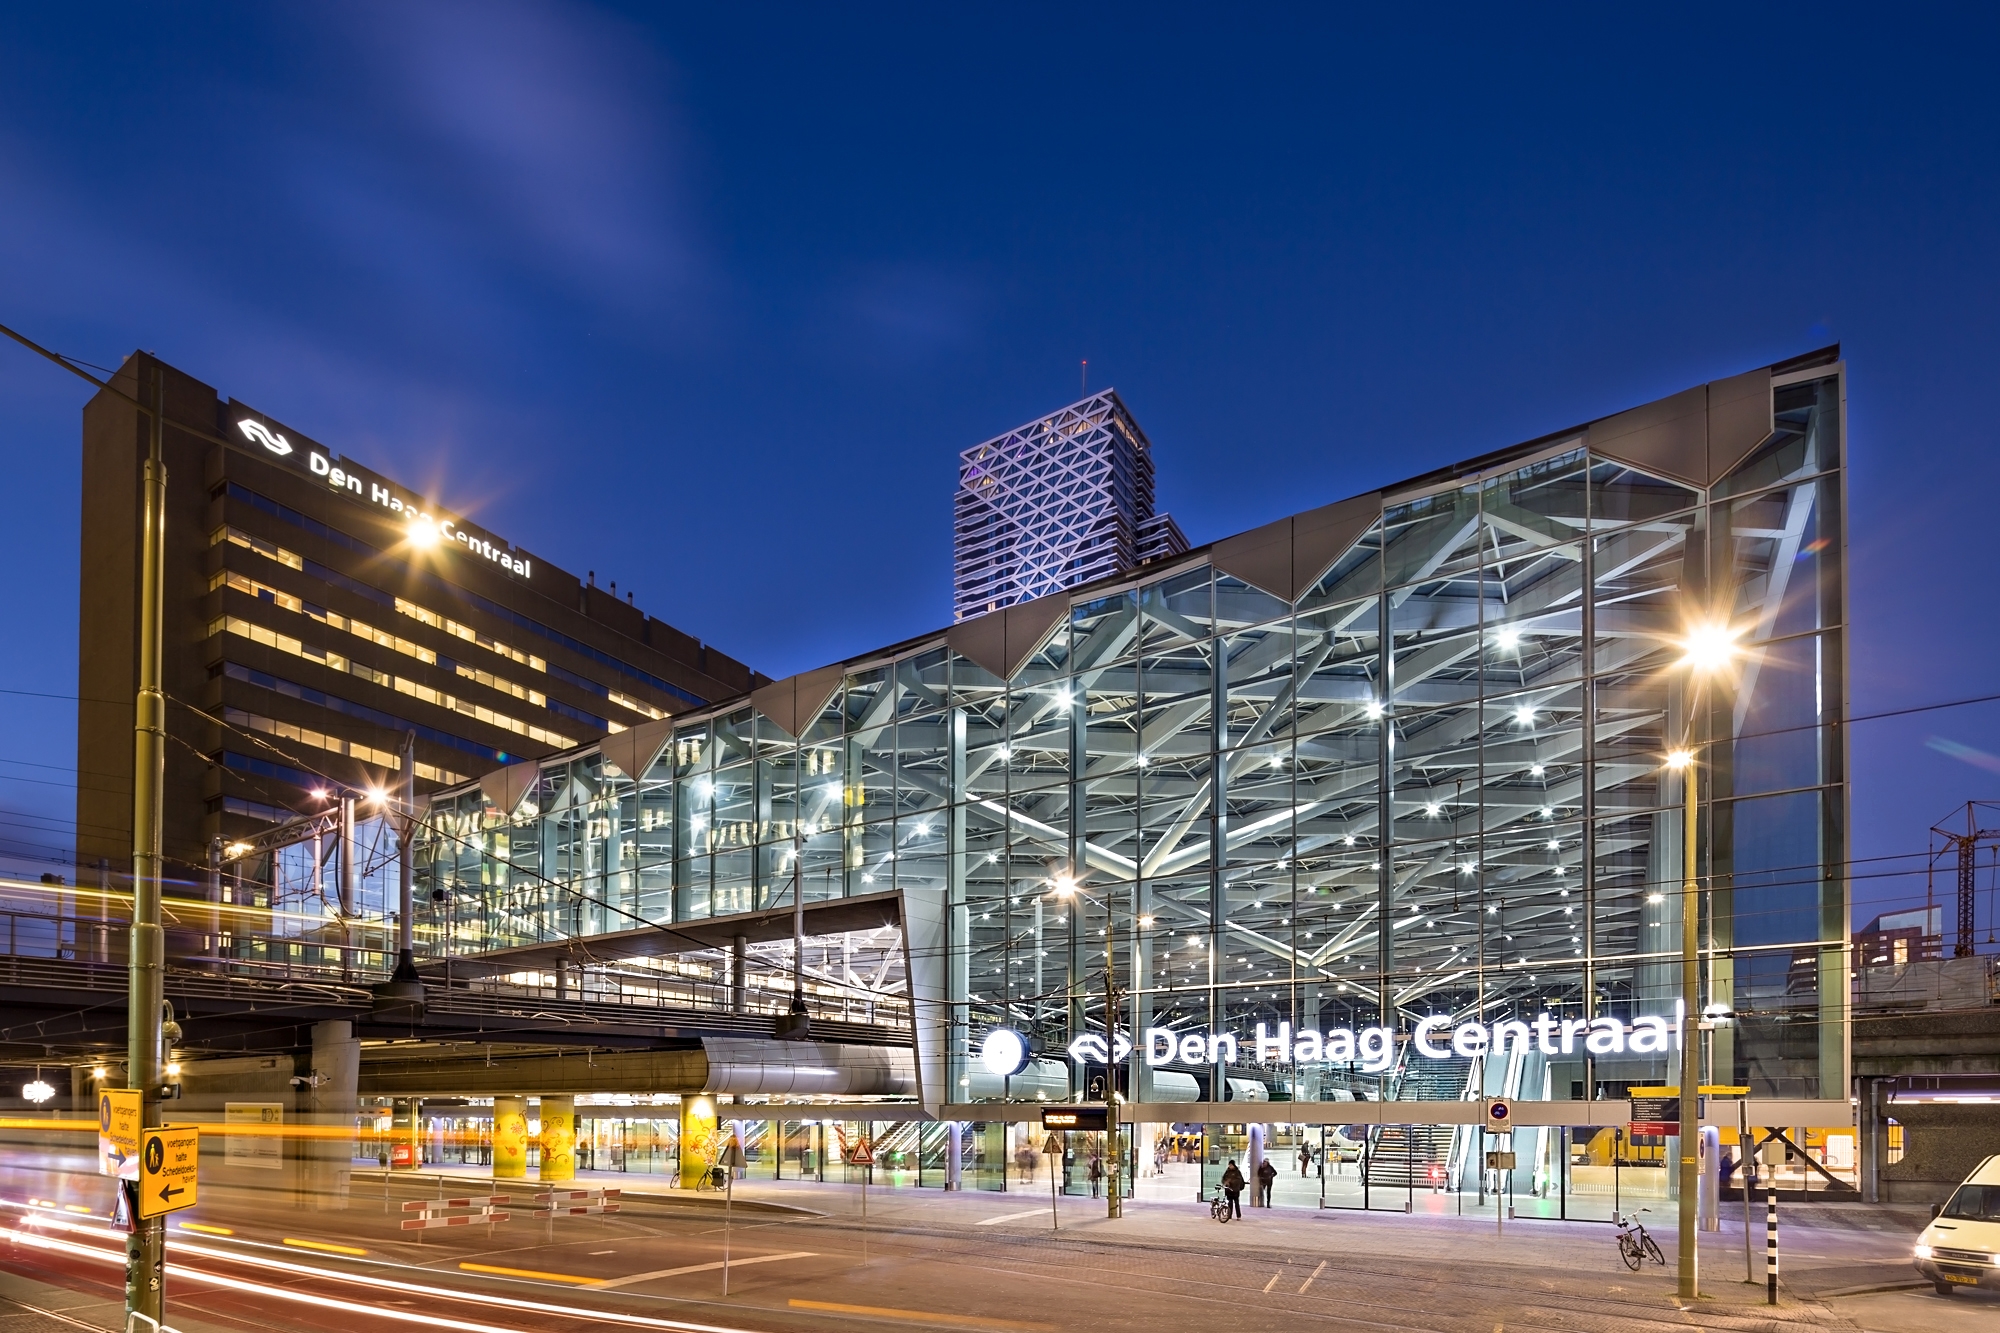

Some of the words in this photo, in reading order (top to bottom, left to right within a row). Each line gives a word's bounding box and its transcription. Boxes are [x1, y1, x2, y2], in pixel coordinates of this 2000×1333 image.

[310, 452, 362, 494] Den
[440, 520, 531, 579] Centraal
[1145, 1028, 1237, 1065] Den
[1256, 1021, 1393, 1072] Haag
[1413, 998, 1684, 1059] Centraal
[113, 1105, 137, 1118] voetgangers
[119, 1121, 129, 1131] halte
[167, 1137, 196, 1149] voetgangers
[175, 1152, 187, 1162] halte
[162, 1164, 197, 1177] Schedeldoeks-
[182, 1174, 196, 1184] haven
